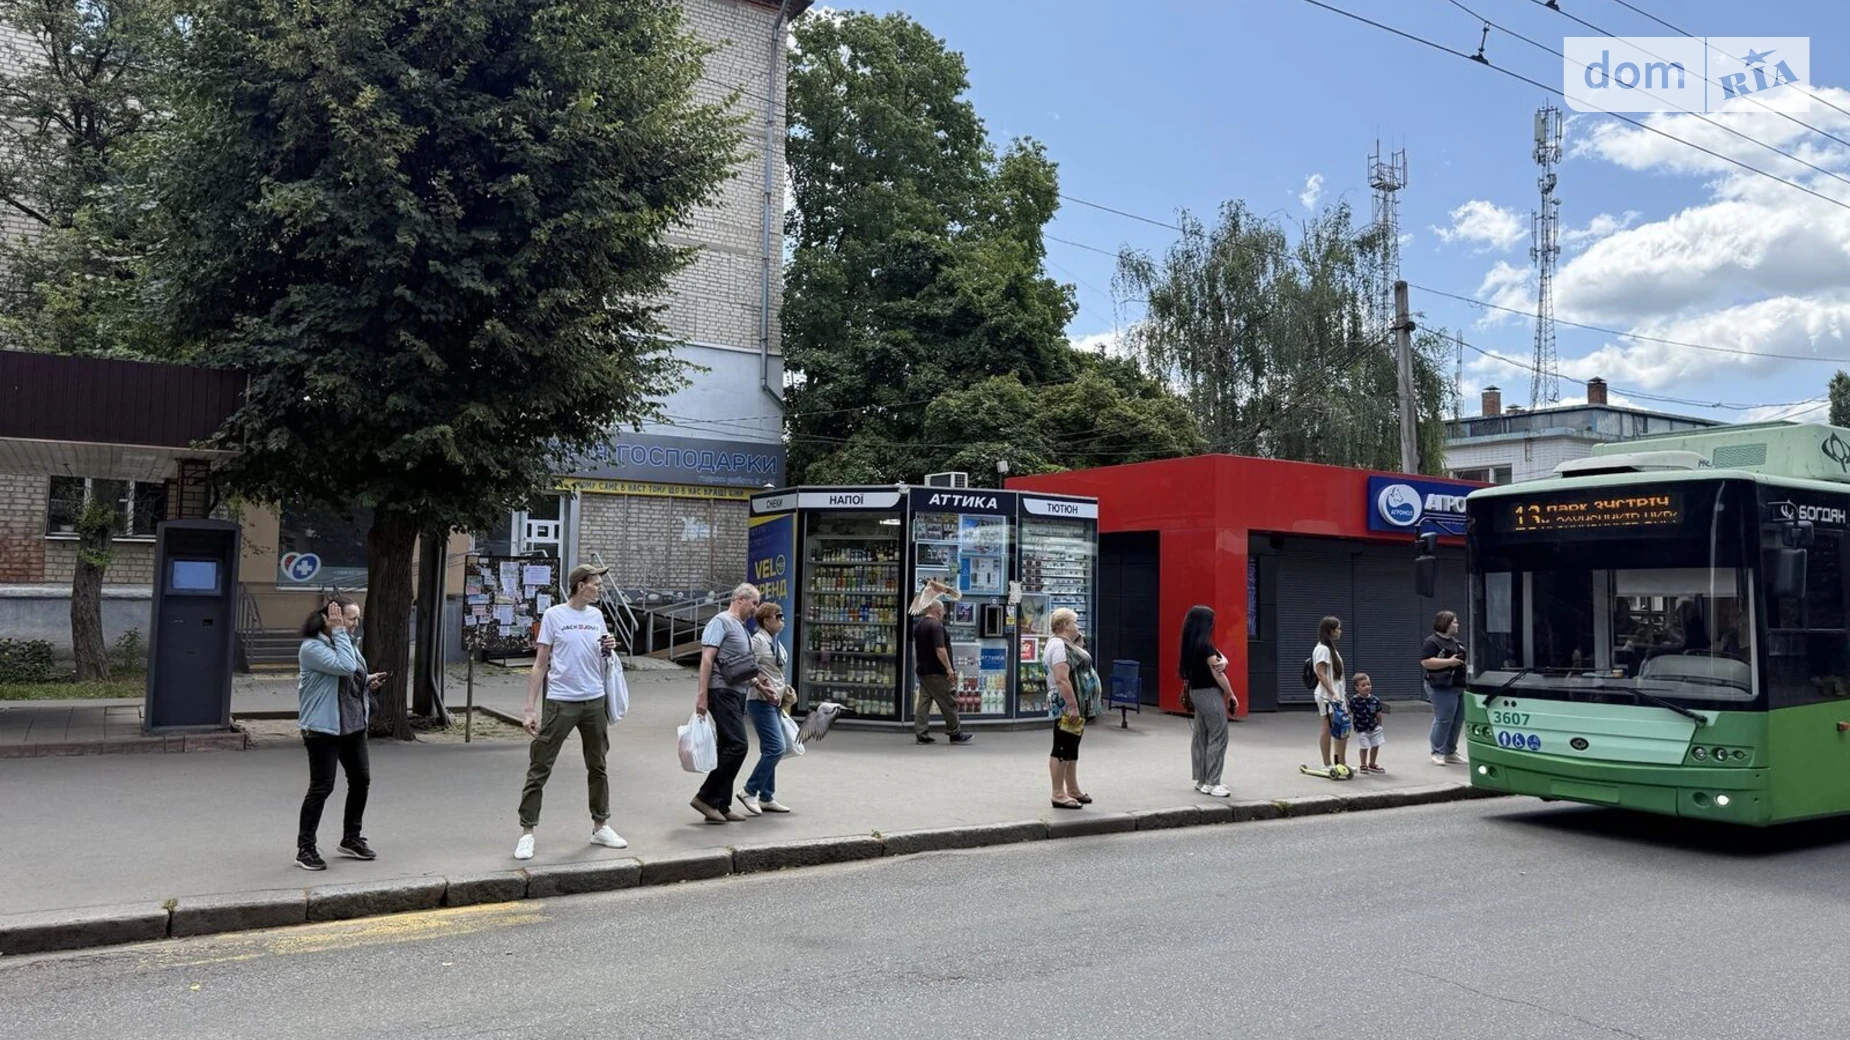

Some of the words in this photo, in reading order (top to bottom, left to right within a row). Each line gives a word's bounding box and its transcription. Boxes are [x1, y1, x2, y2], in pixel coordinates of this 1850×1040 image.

[616, 443, 777, 474] ГОСПОДАРКИ
[829, 493, 865, 505] НАПОЇ
[928, 493, 998, 510] АТТИКА
[1047, 503, 1079, 515] ТЮТЮН
[1798, 505, 1846, 524] БОГДАН
[1493, 711, 1531, 726] 3607
